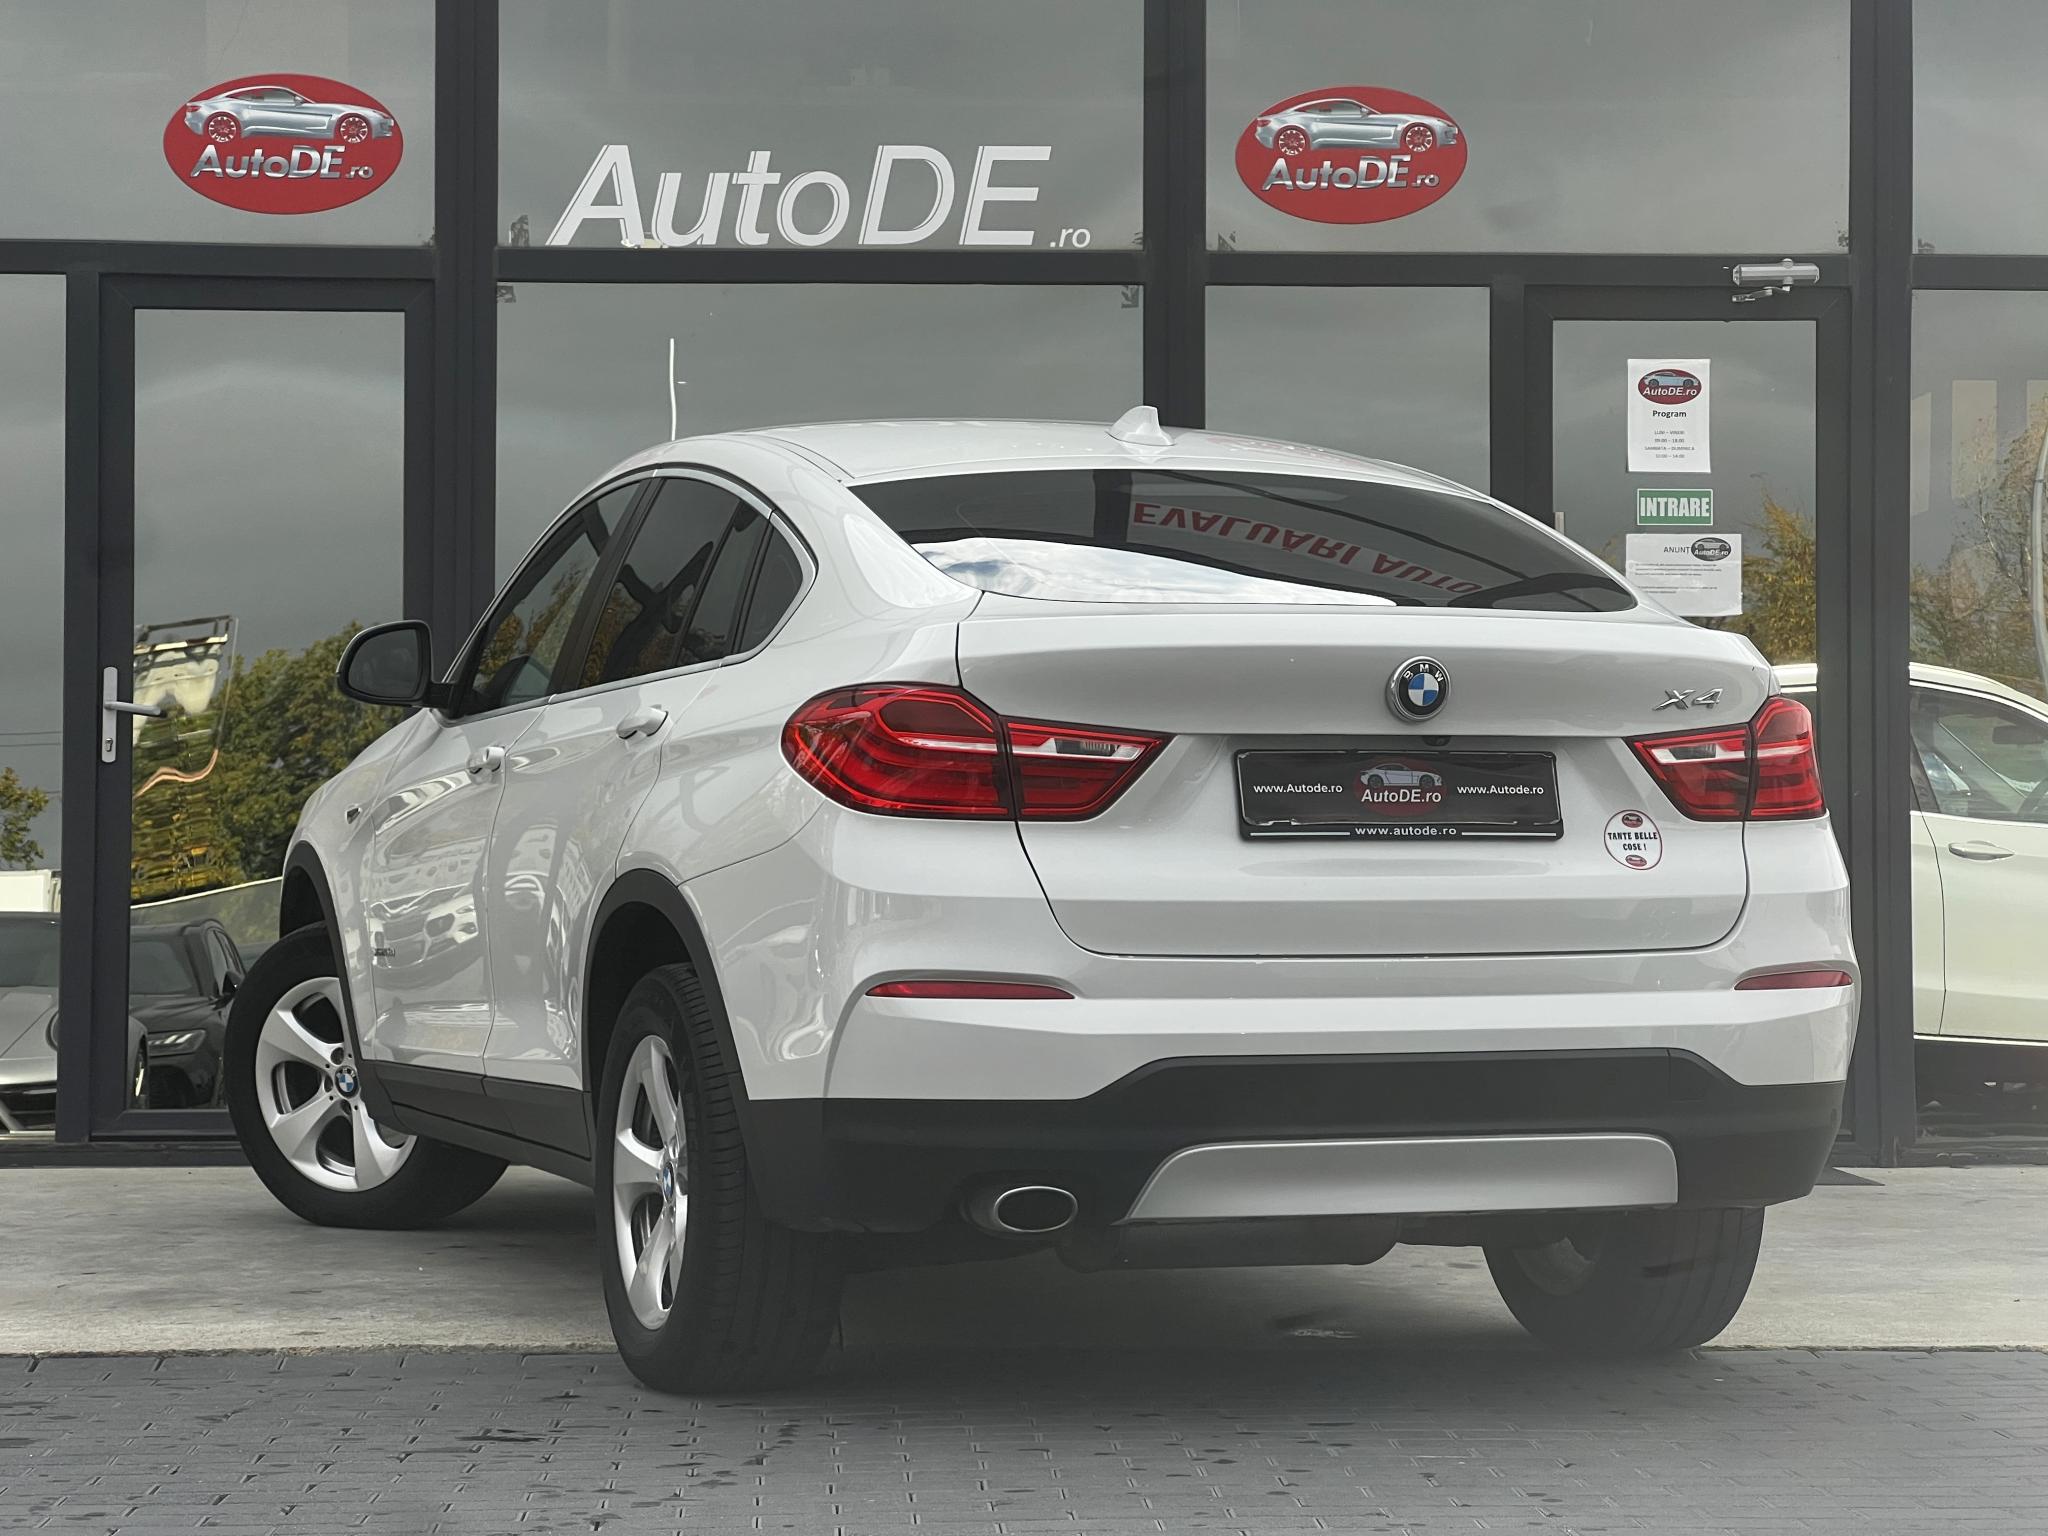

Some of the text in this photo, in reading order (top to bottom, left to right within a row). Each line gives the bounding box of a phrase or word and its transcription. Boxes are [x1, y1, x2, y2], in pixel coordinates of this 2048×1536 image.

[1642, 387, 1698, 396] AutoDE.ro
[1652, 410, 1687, 419] Program
[1640, 497, 1710, 517] INTRARE
[1404, 663, 1444, 682] BMW
[1652, 688, 1723, 711] X4
[1253, 783, 1343, 794] www.Autode.ro
[1457, 785, 1544, 795] www.Autode.ro
[1361, 788, 1442, 803] AutoDE.ro
[1355, 826, 1457, 836] www.autode.ro
[1607, 832, 1658, 840] TANTE BELLE
[1622, 843, 1643, 851] COSE
